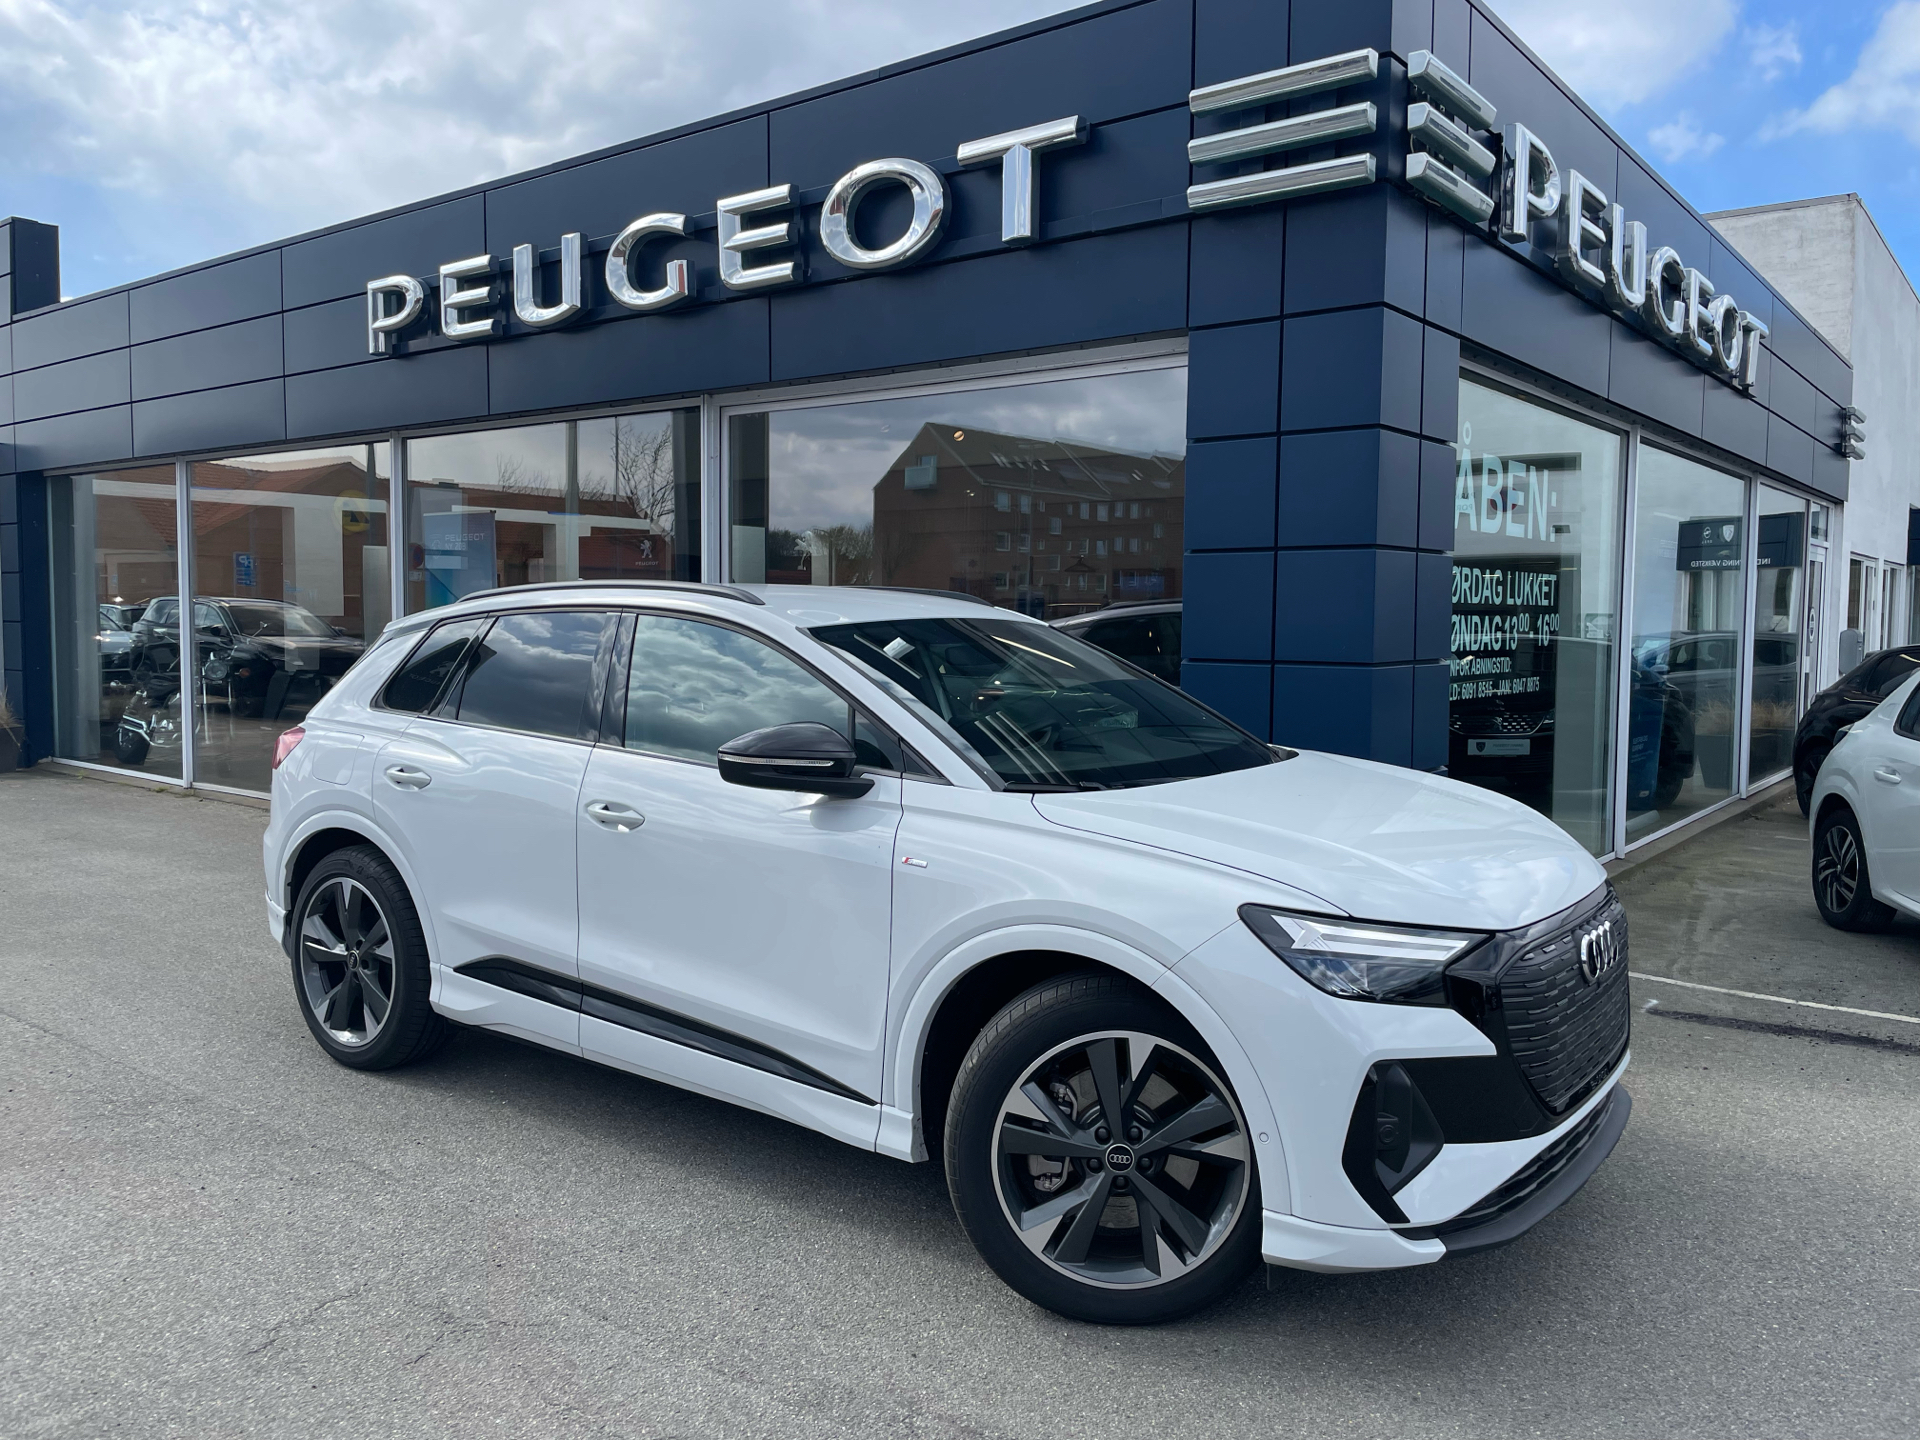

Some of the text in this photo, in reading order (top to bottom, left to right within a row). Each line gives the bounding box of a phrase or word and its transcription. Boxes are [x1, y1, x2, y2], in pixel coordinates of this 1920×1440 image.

[366, 115, 1086, 356] PEUGEOT
[1502, 123, 1769, 389] PEUGEOT
[1455, 421, 1557, 543] ÅBEN:
[444, 532, 486, 542] PEUGEOT
[1507, 570, 1557, 606] LUKKET
[1462, 681, 1477, 699] 6091
[1478, 681, 1493, 698] 8515
[1513, 678, 1526, 695] 6047
